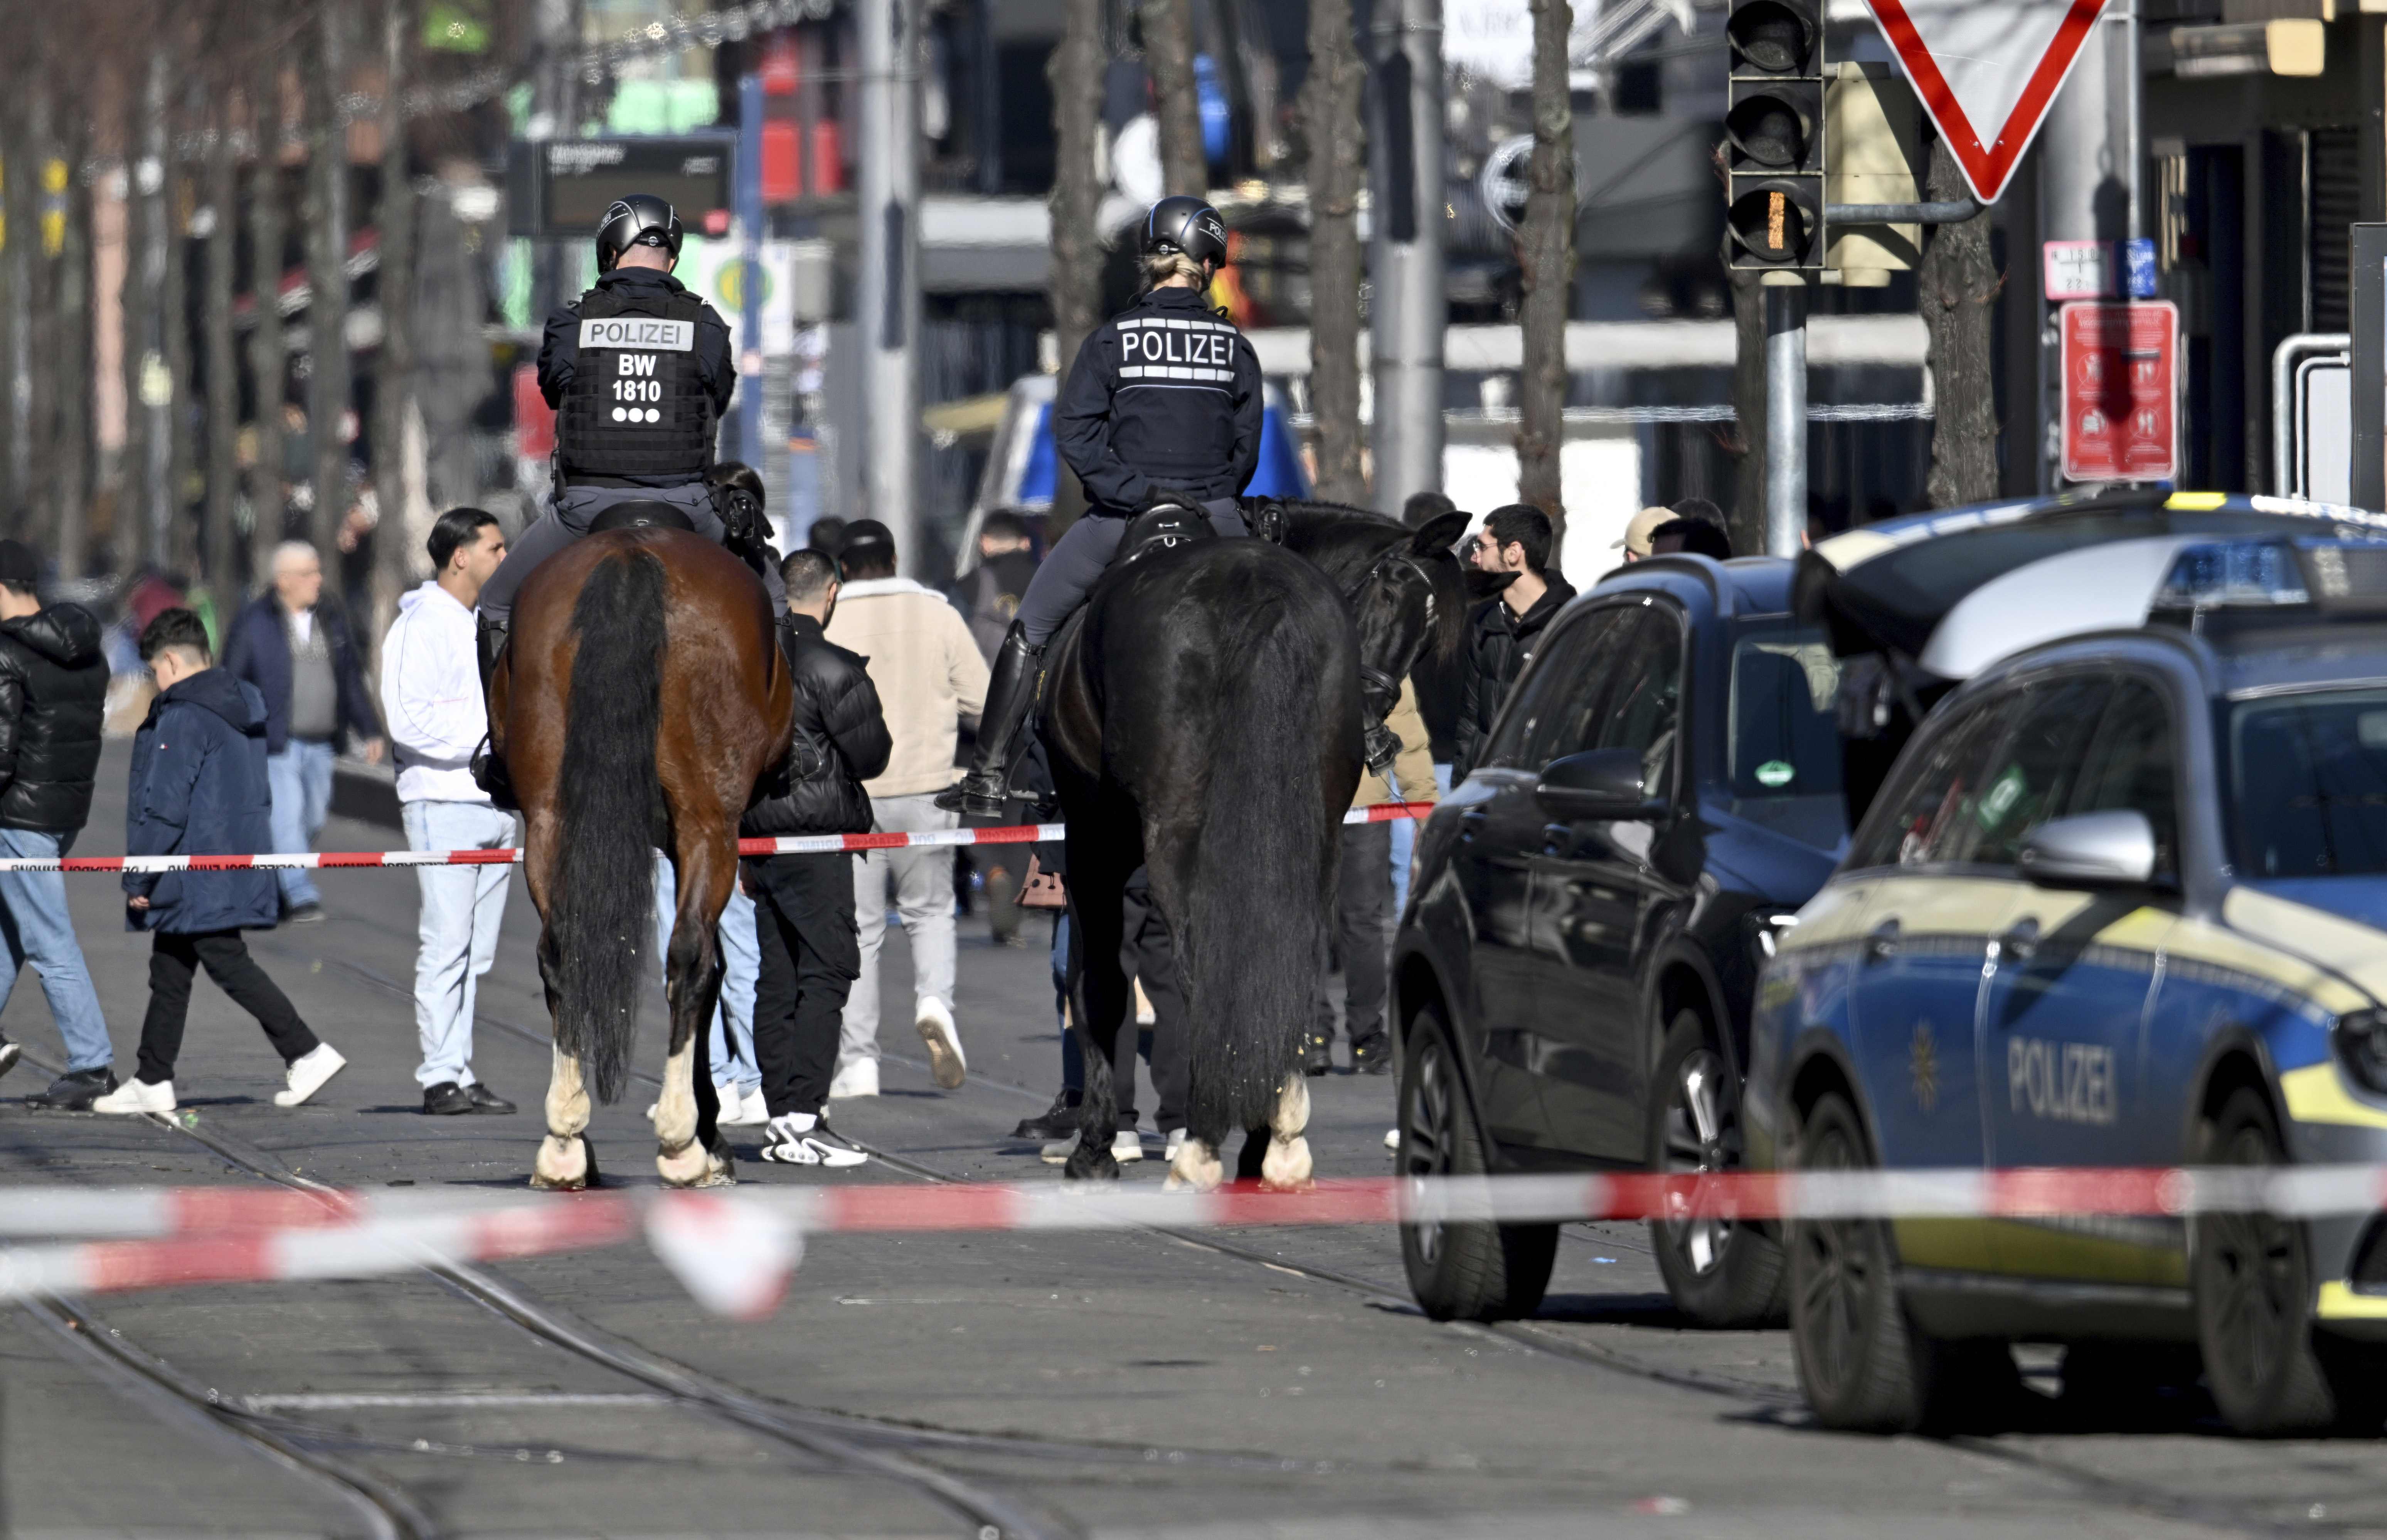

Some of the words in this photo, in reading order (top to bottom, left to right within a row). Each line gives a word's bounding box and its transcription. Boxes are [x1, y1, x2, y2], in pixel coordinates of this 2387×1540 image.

[591, 323, 680, 344] POLIZEI
[1122, 331, 1234, 365] POLIZEI
[619, 354, 656, 376] BW
[613, 380, 661, 402] 1810
[2008, 1037, 2118, 1124] POLIZEI
